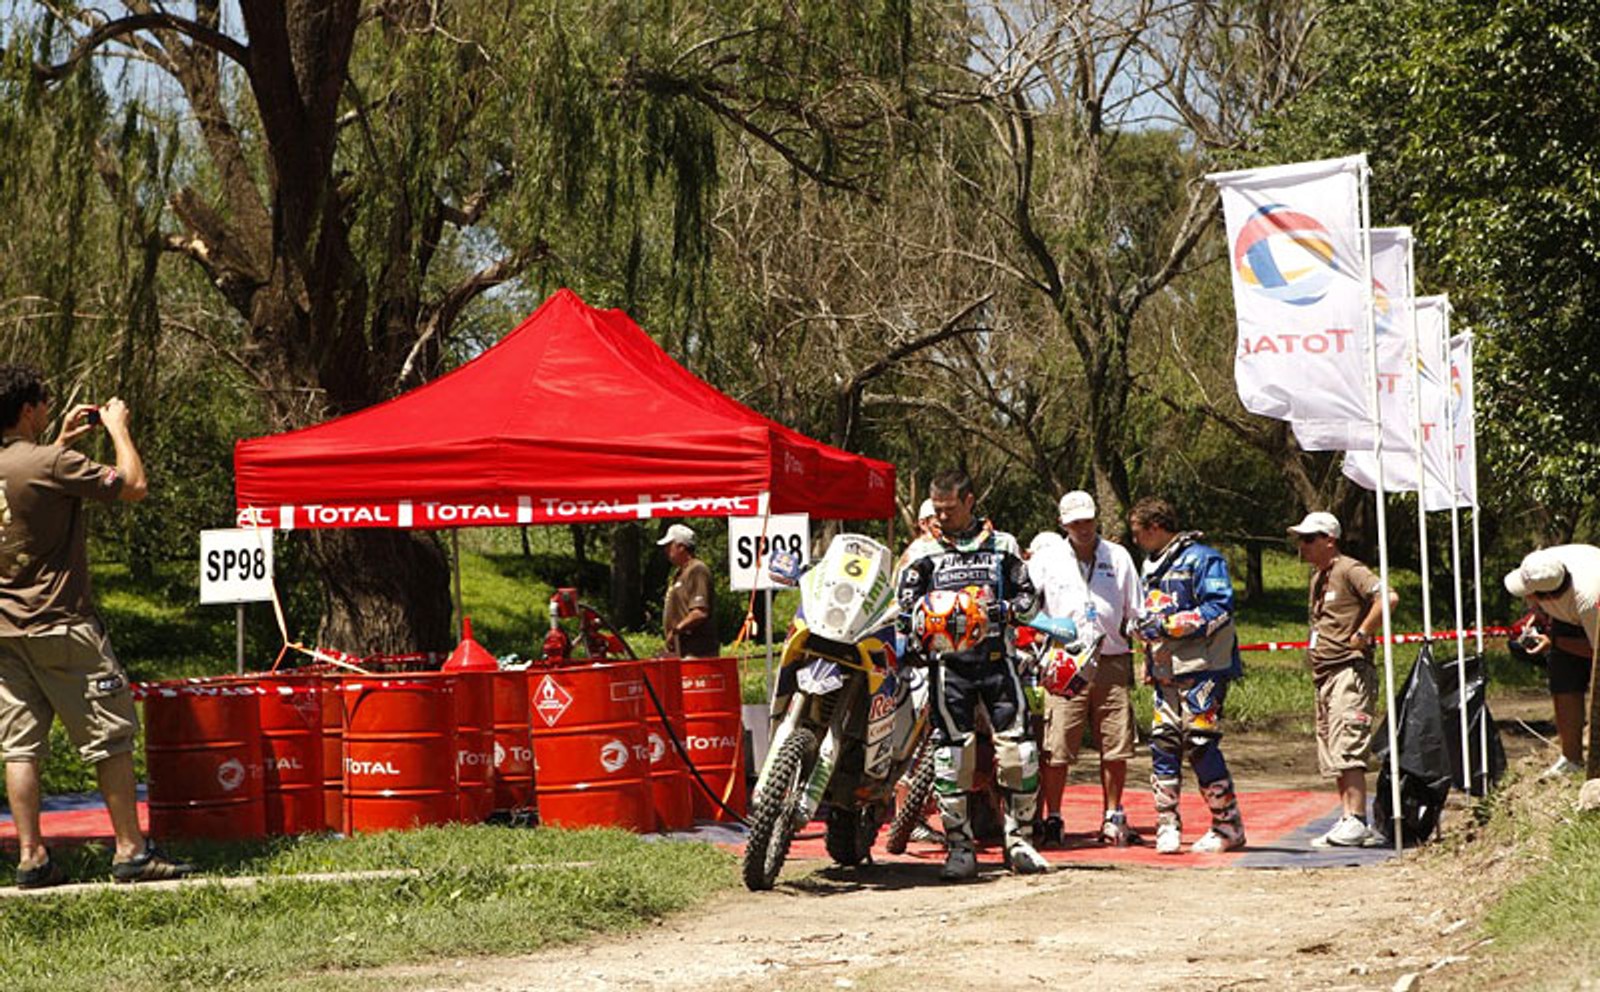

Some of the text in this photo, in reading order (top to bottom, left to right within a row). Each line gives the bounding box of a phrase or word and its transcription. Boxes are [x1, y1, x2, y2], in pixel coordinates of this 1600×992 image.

[302, 504, 391, 524] TOTAL
[421, 501, 510, 521] TOTAL
[540, 498, 628, 516] TOTAL
[206, 548, 266, 582] SP98
[844, 559, 863, 577] 6
[686, 735, 736, 750] TOTAL
[343, 757, 400, 774] TOTAL
